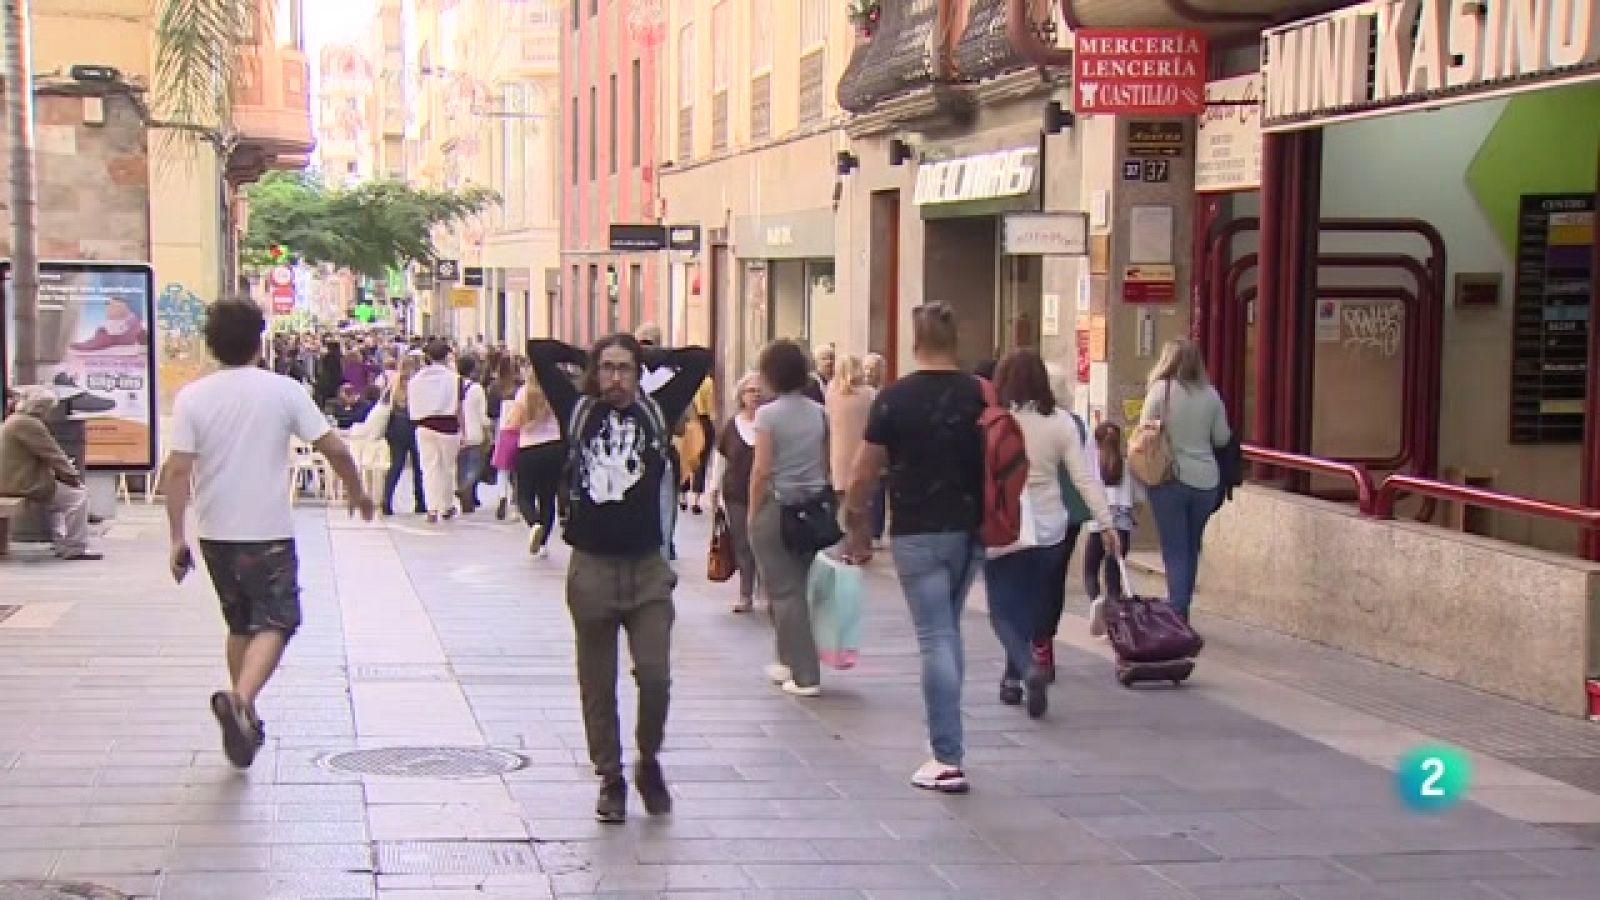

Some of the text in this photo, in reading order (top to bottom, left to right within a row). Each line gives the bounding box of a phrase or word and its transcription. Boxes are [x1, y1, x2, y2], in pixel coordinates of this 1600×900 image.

[1079, 33, 1199, 53] MERCERÍA
[1081, 57, 1196, 76] LENCERÍA
[1266, 14, 1371, 119] MINI
[1100, 84, 1179, 106] CASTILLO
[1145, 160, 1166, 181] 37
